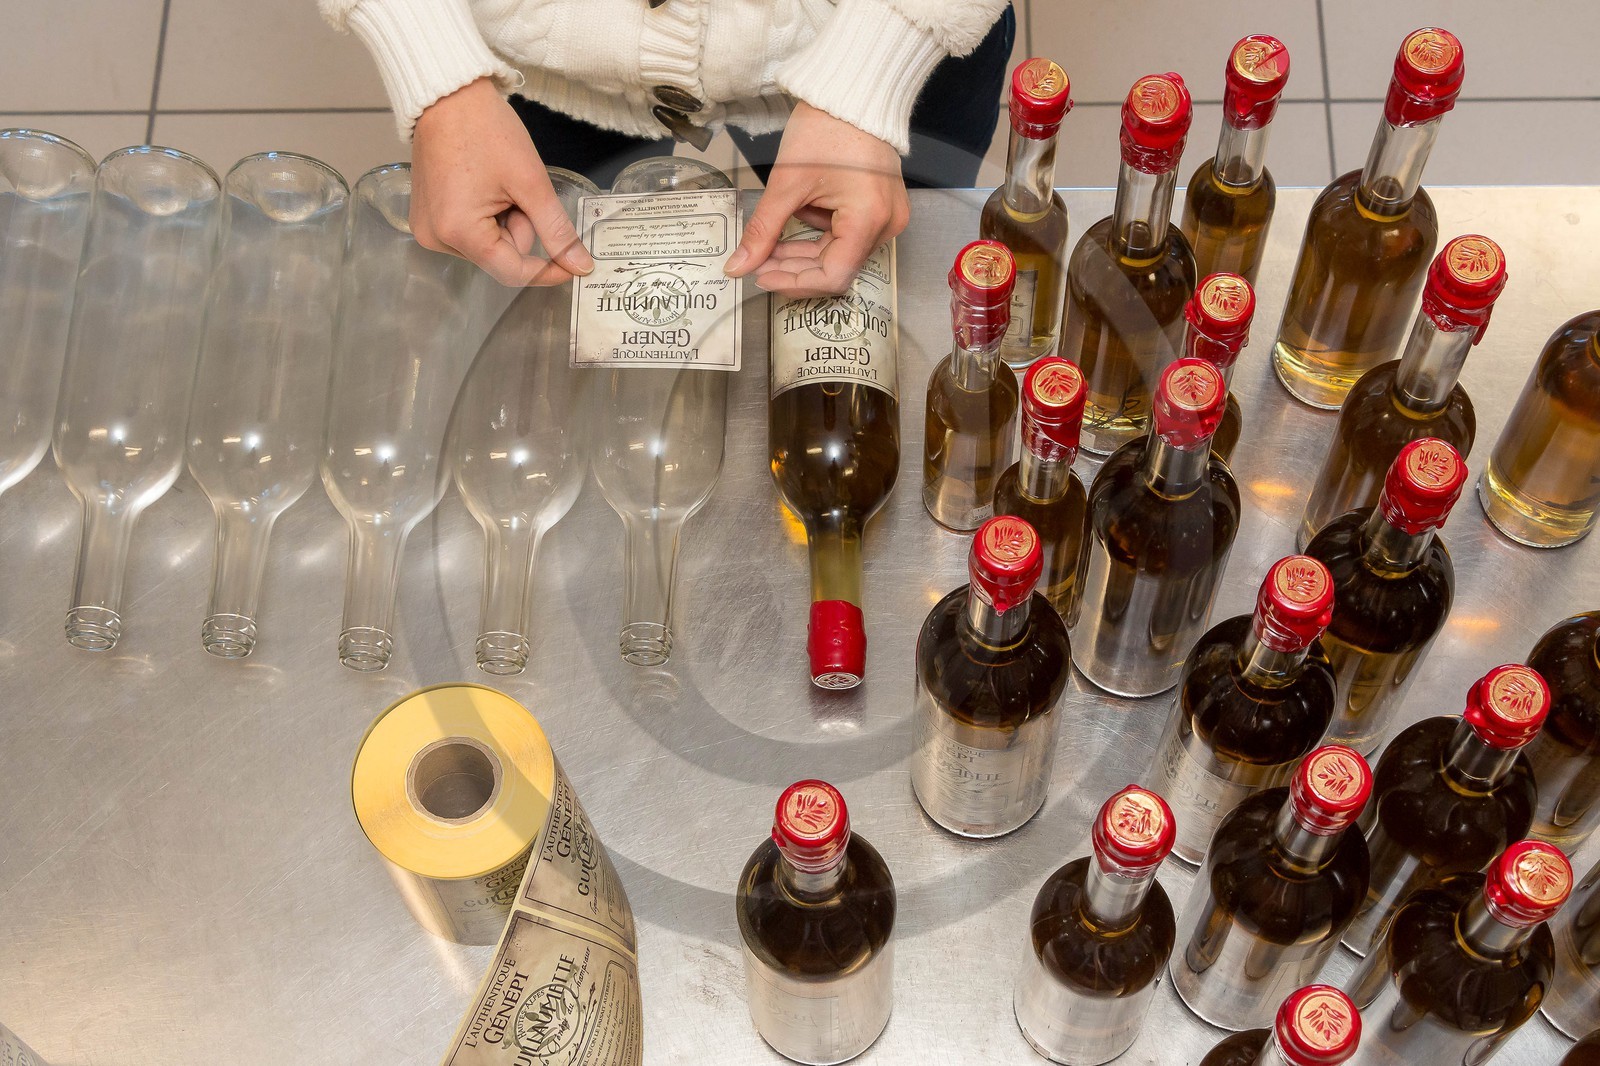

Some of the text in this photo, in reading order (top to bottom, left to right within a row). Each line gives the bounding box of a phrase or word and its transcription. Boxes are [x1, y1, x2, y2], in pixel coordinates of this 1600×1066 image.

[622, 203, 698, 213] WWW.GUILLAUMETTE.COM
[597, 294, 716, 311] GUILLAUMETTE
[783, 309, 887, 338] GUILLAUMETTE
[622, 329, 690, 348] GÉNÉPI
[612, 348, 698, 359] L'AUTHENTIQUE
[805, 346, 870, 365] GÉNÉPI
[797, 366, 877, 380] L'AUTHENTIQUE
[465, 958, 516, 1048] L'AUTHENTIQUE
[483, 971, 530, 1044] GÉNÉPI
[513, 953, 575, 1066] UILLAUMETTE
